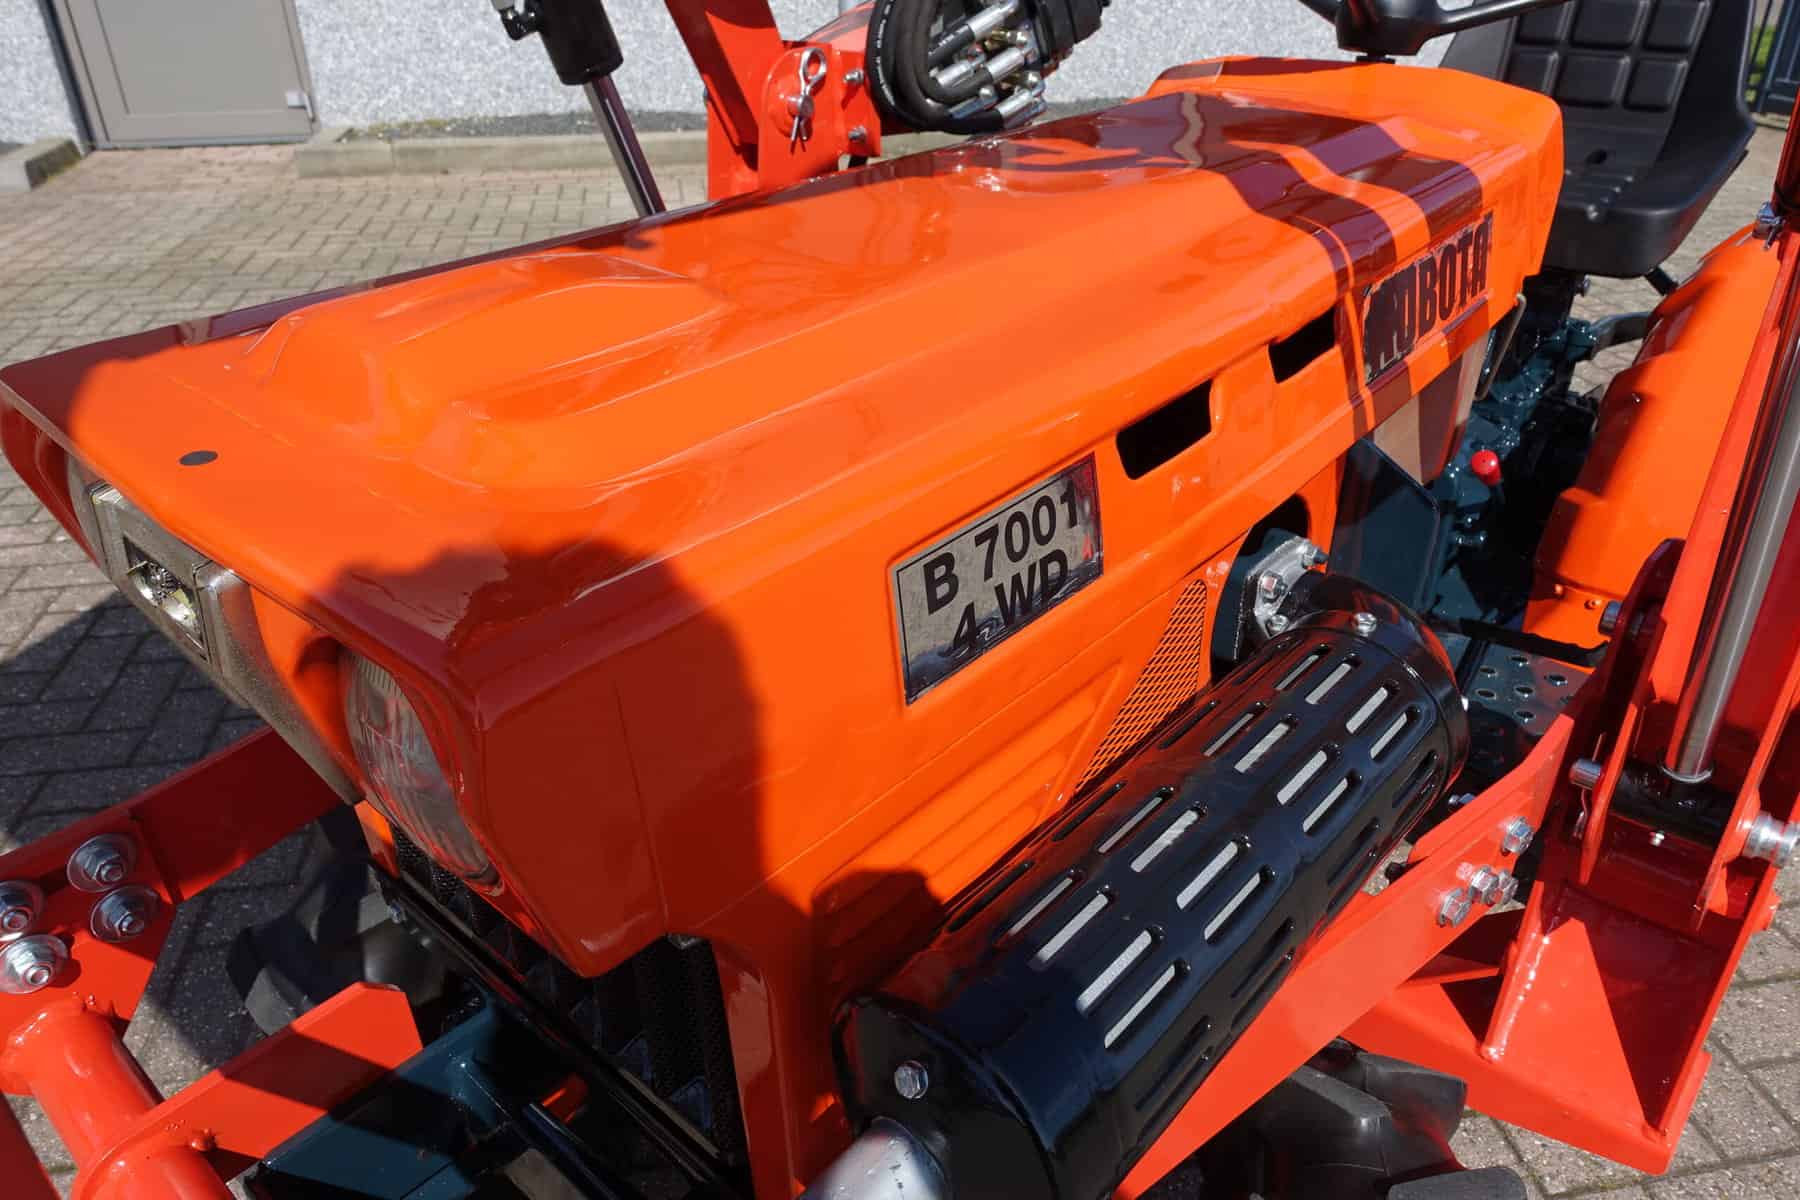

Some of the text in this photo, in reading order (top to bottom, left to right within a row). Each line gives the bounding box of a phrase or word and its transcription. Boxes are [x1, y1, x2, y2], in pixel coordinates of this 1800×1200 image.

[923, 479, 1078, 615] B 7001
[953, 548, 1070, 651] 4 WD
